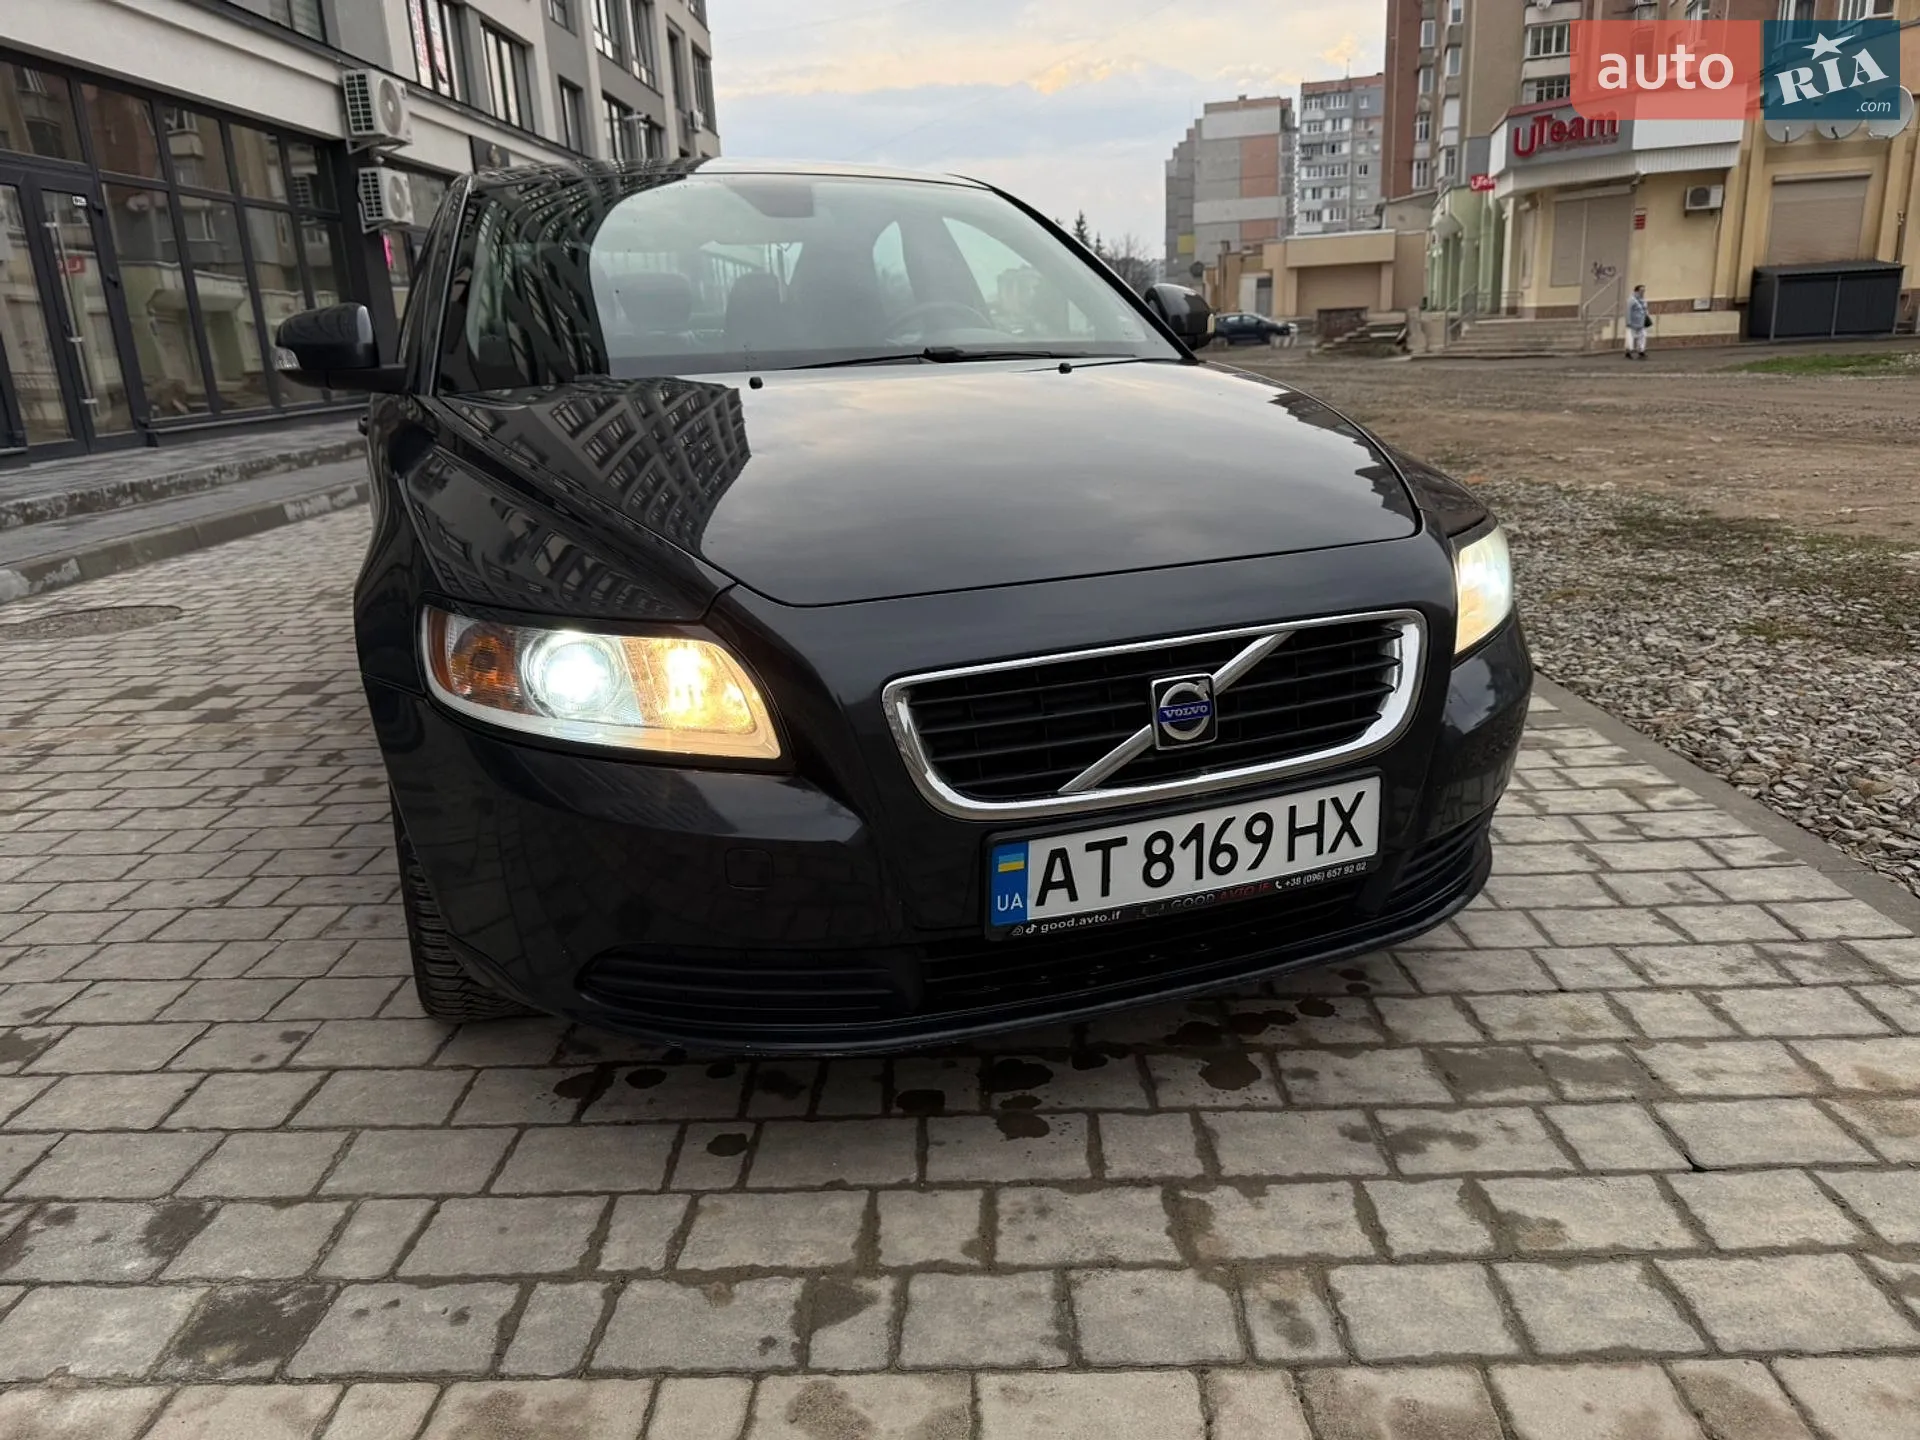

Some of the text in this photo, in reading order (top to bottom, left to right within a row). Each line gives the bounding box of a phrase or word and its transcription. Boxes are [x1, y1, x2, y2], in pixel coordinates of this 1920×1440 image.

[1513, 110, 1620, 158] UTeam
[1163, 705, 1208, 718] VOLVO
[1035, 791, 1366, 907] AT 8169 HX
[1326, 867, 1343, 879] 657
[997, 892, 1023, 911] UA
[1171, 893, 1215, 909] GOOD
[1041, 910, 1122, 934] good.avto.if
